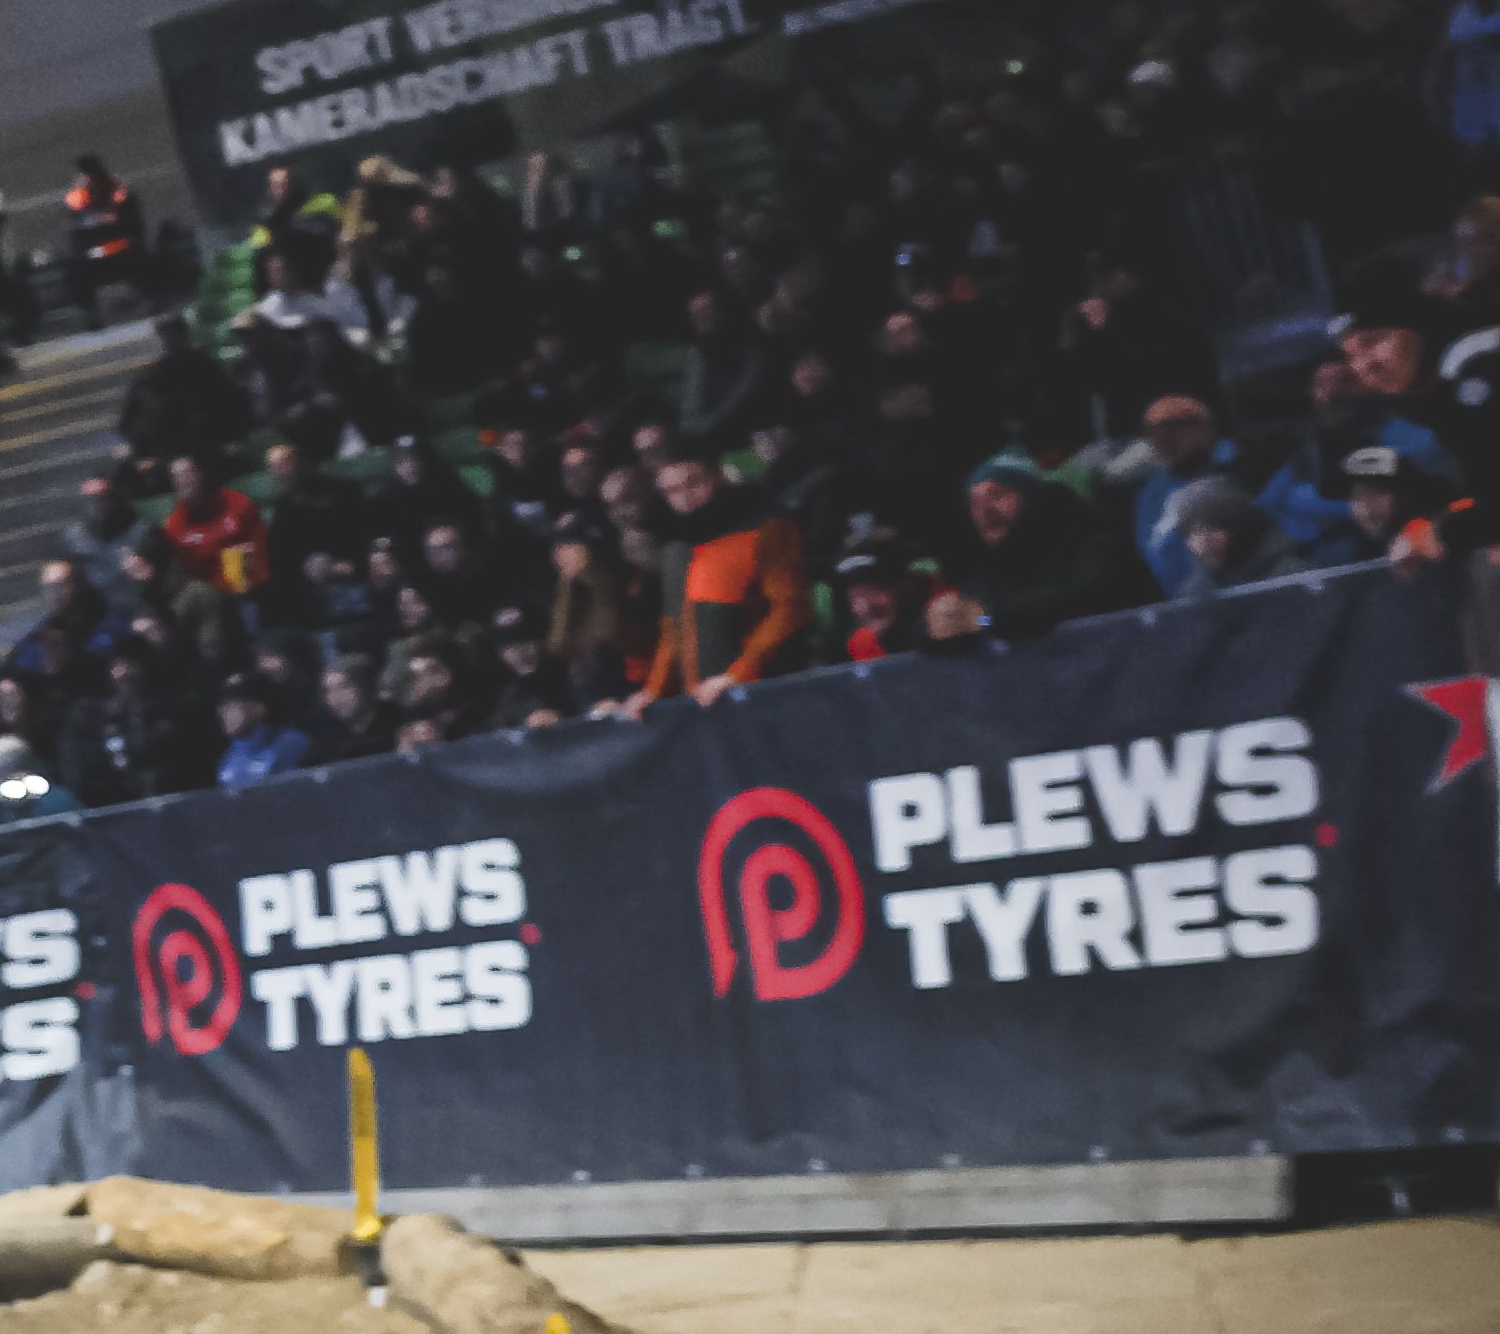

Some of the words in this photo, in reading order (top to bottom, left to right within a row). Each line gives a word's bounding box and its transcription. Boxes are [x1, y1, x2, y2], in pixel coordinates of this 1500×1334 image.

[255, 16, 395, 95] SPORT
[867, 716, 1320, 874] PLEWS
[236, 835, 528, 958] PLEWS
[885, 844, 1322, 991] TYRES
[250, 938, 532, 1053] TYRES
